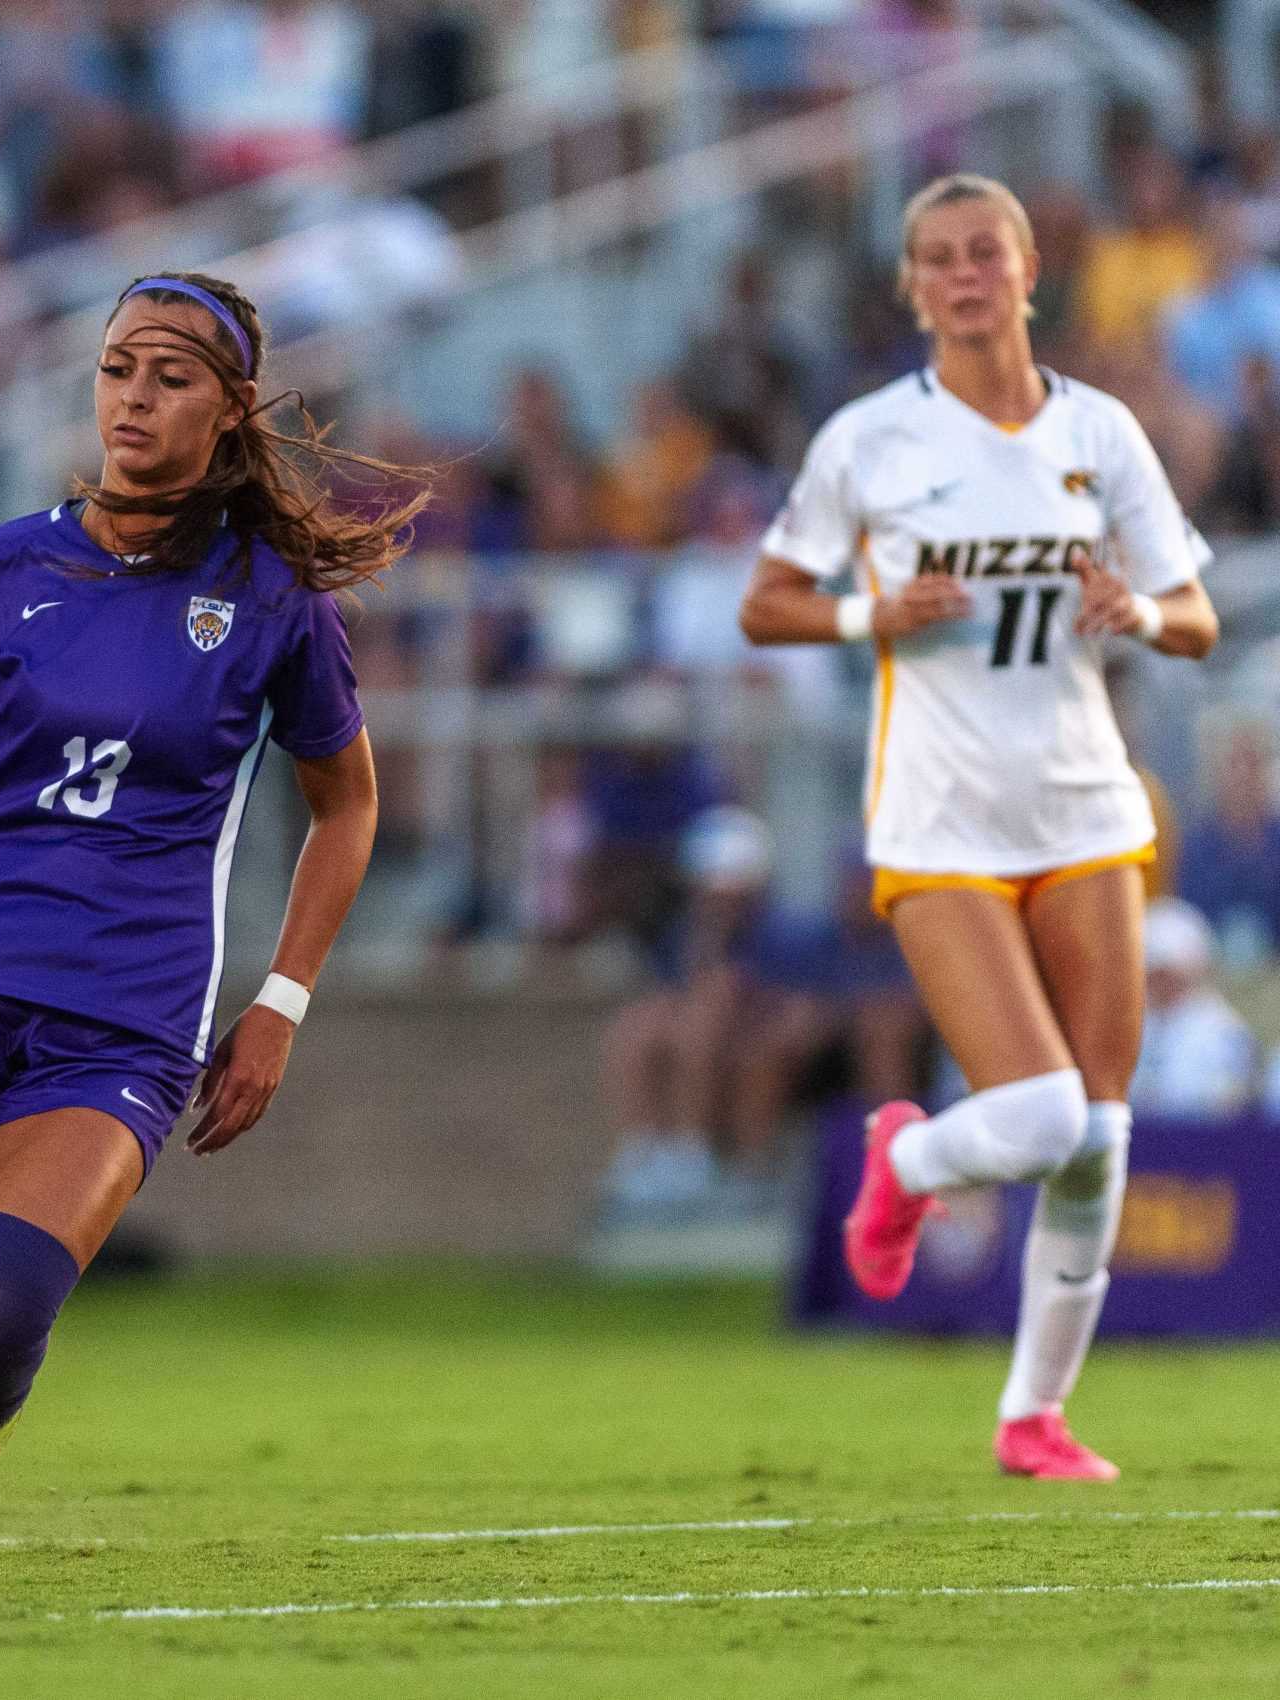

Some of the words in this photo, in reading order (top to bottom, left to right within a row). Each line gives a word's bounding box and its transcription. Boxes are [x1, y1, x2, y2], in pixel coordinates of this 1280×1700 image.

[201, 601, 223, 612] LSU
[990, 585, 1063, 667] 11
[36, 736, 133, 819] 13
